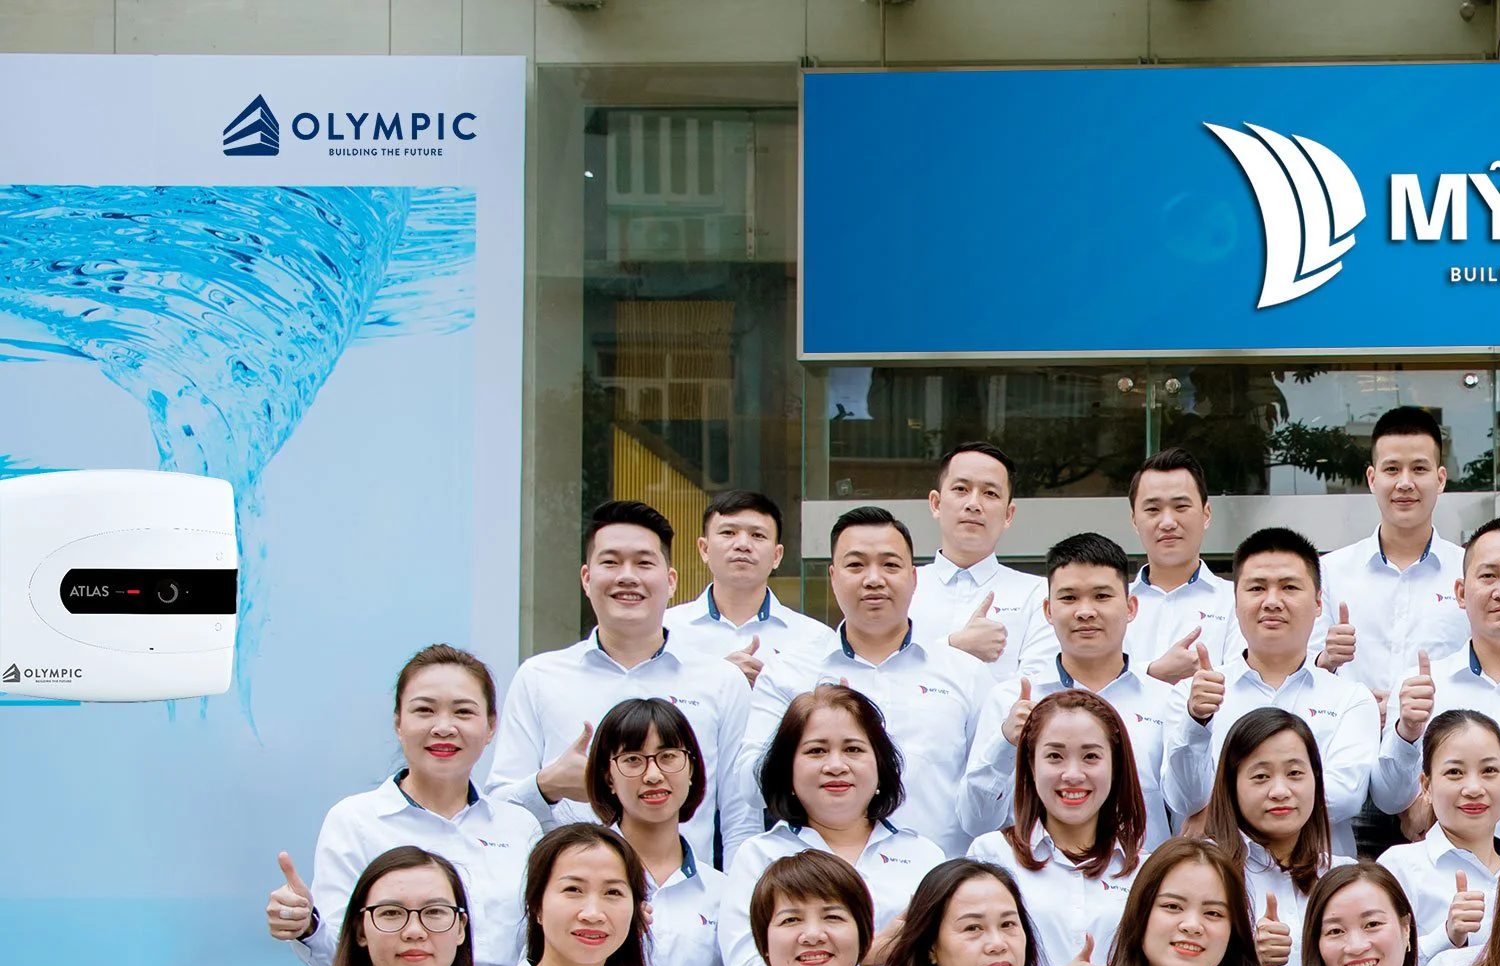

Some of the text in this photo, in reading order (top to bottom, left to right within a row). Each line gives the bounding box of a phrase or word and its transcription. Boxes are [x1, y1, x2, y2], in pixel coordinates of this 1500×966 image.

[292, 112, 477, 141] OLYMPIC
[329, 148, 443, 156] BUILDING THE FUTURE
[70, 586, 109, 597] ATLAS
[24, 668, 82, 678] OLYMPIC
